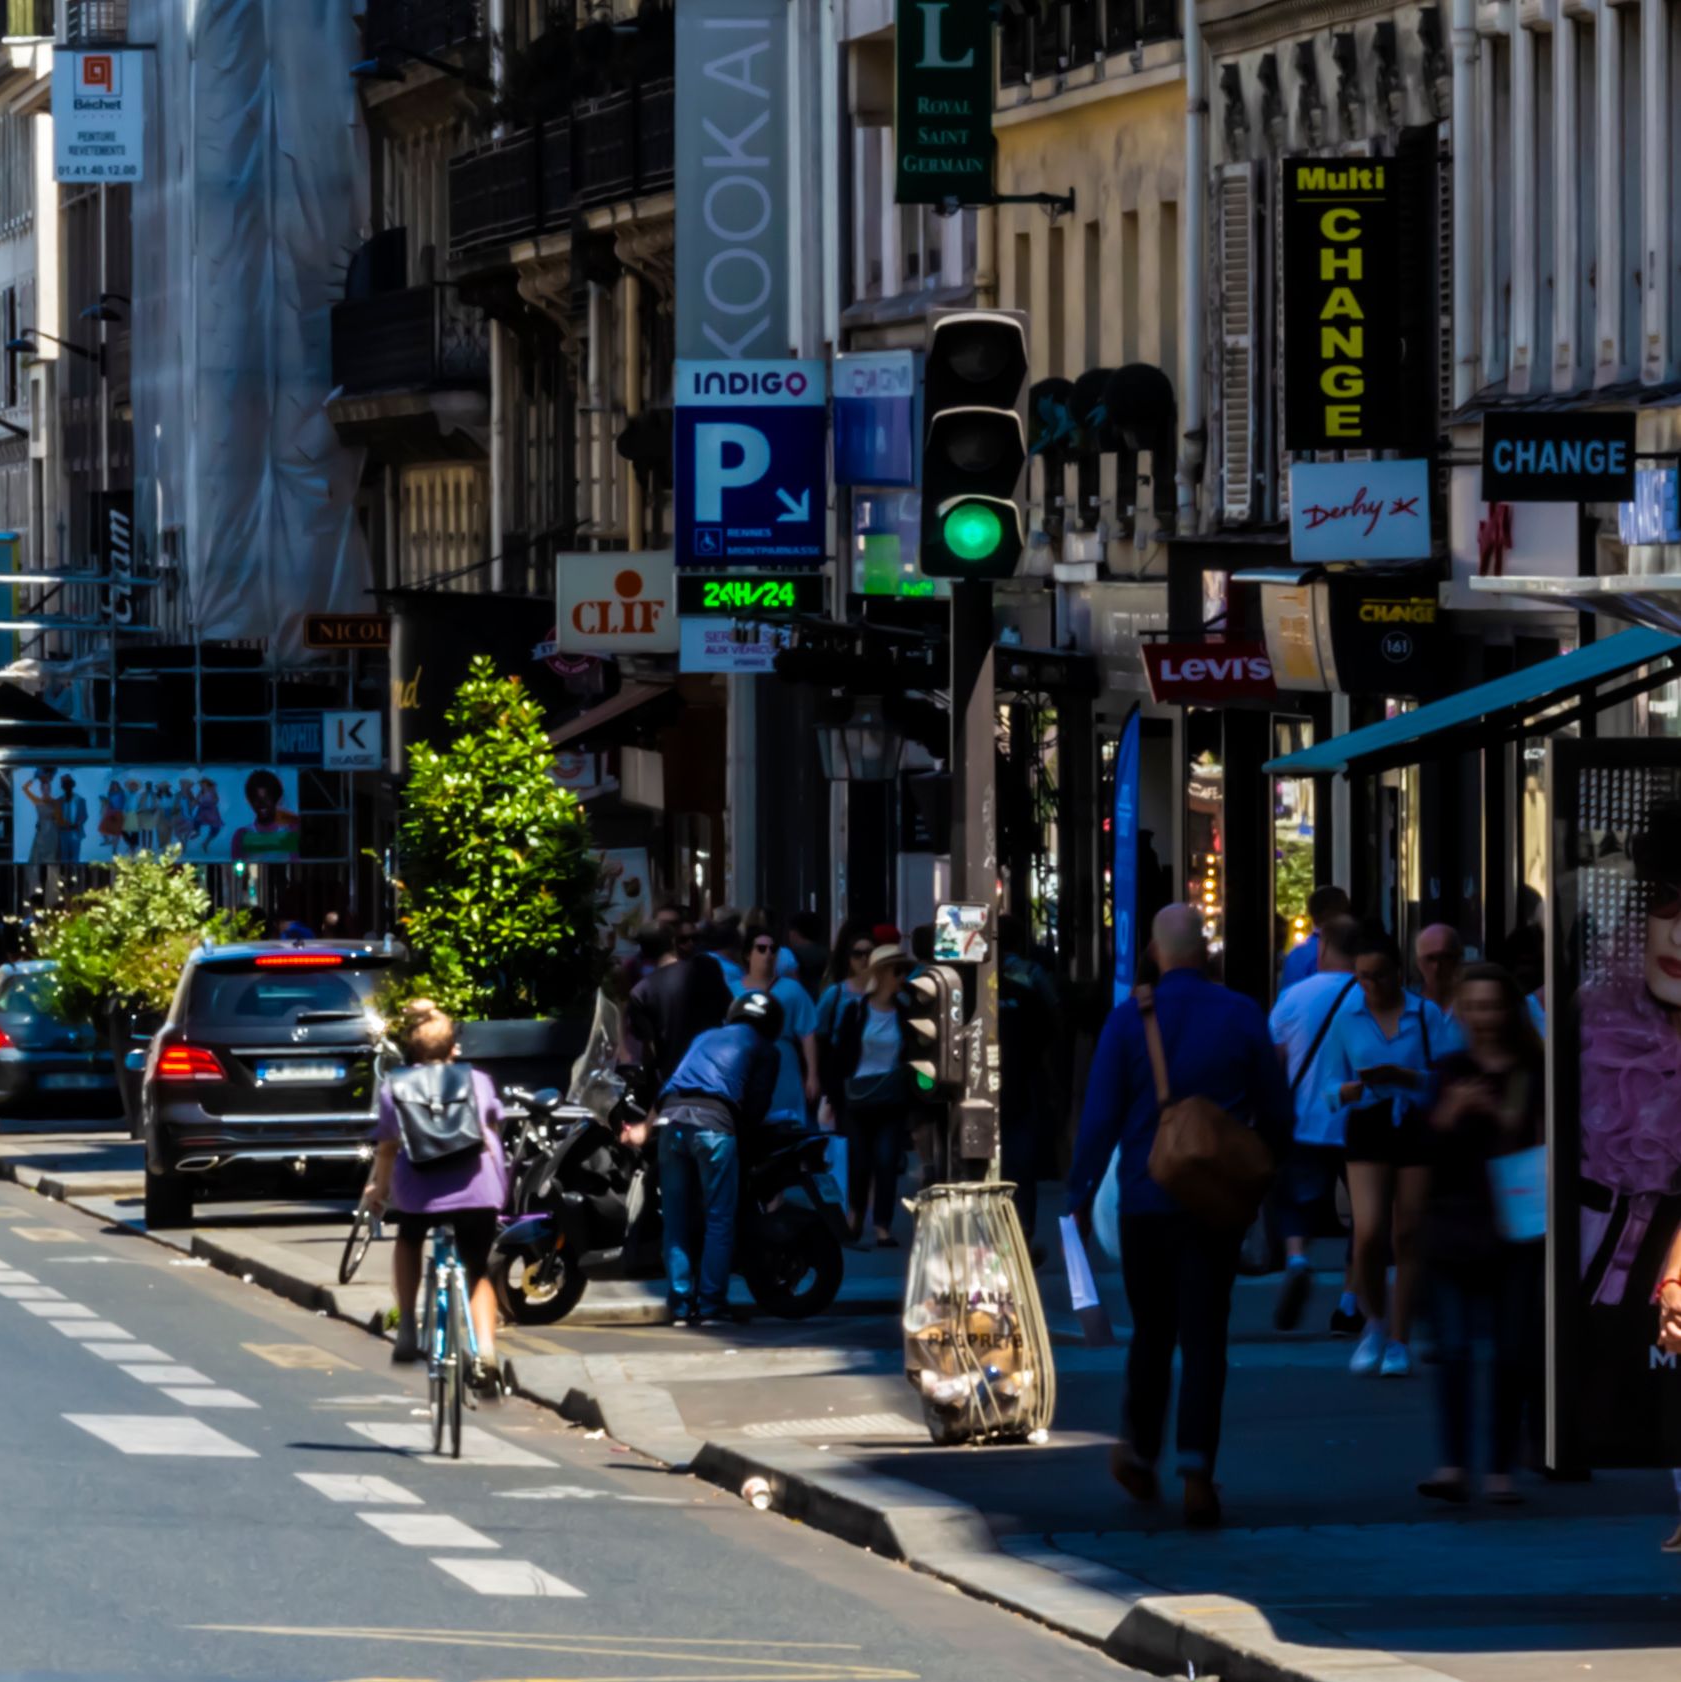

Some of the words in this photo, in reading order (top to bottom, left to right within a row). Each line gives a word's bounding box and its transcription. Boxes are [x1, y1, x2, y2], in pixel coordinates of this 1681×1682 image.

[917, 96, 972, 116] ROYAL
[917, 126, 968, 145] SAINT
[903, 154, 983, 174] GERMAIN
[1297, 166, 1385, 190] Multi
[1319, 208, 1366, 437] CHANGE
[694, 372, 807, 397] INDIGO
[1492, 440, 1627, 475] CHANGE
[694, 422, 771, 522] P
[1359, 604, 1436, 624] CHANGE
[1387, 640, 1408, 655] 161
